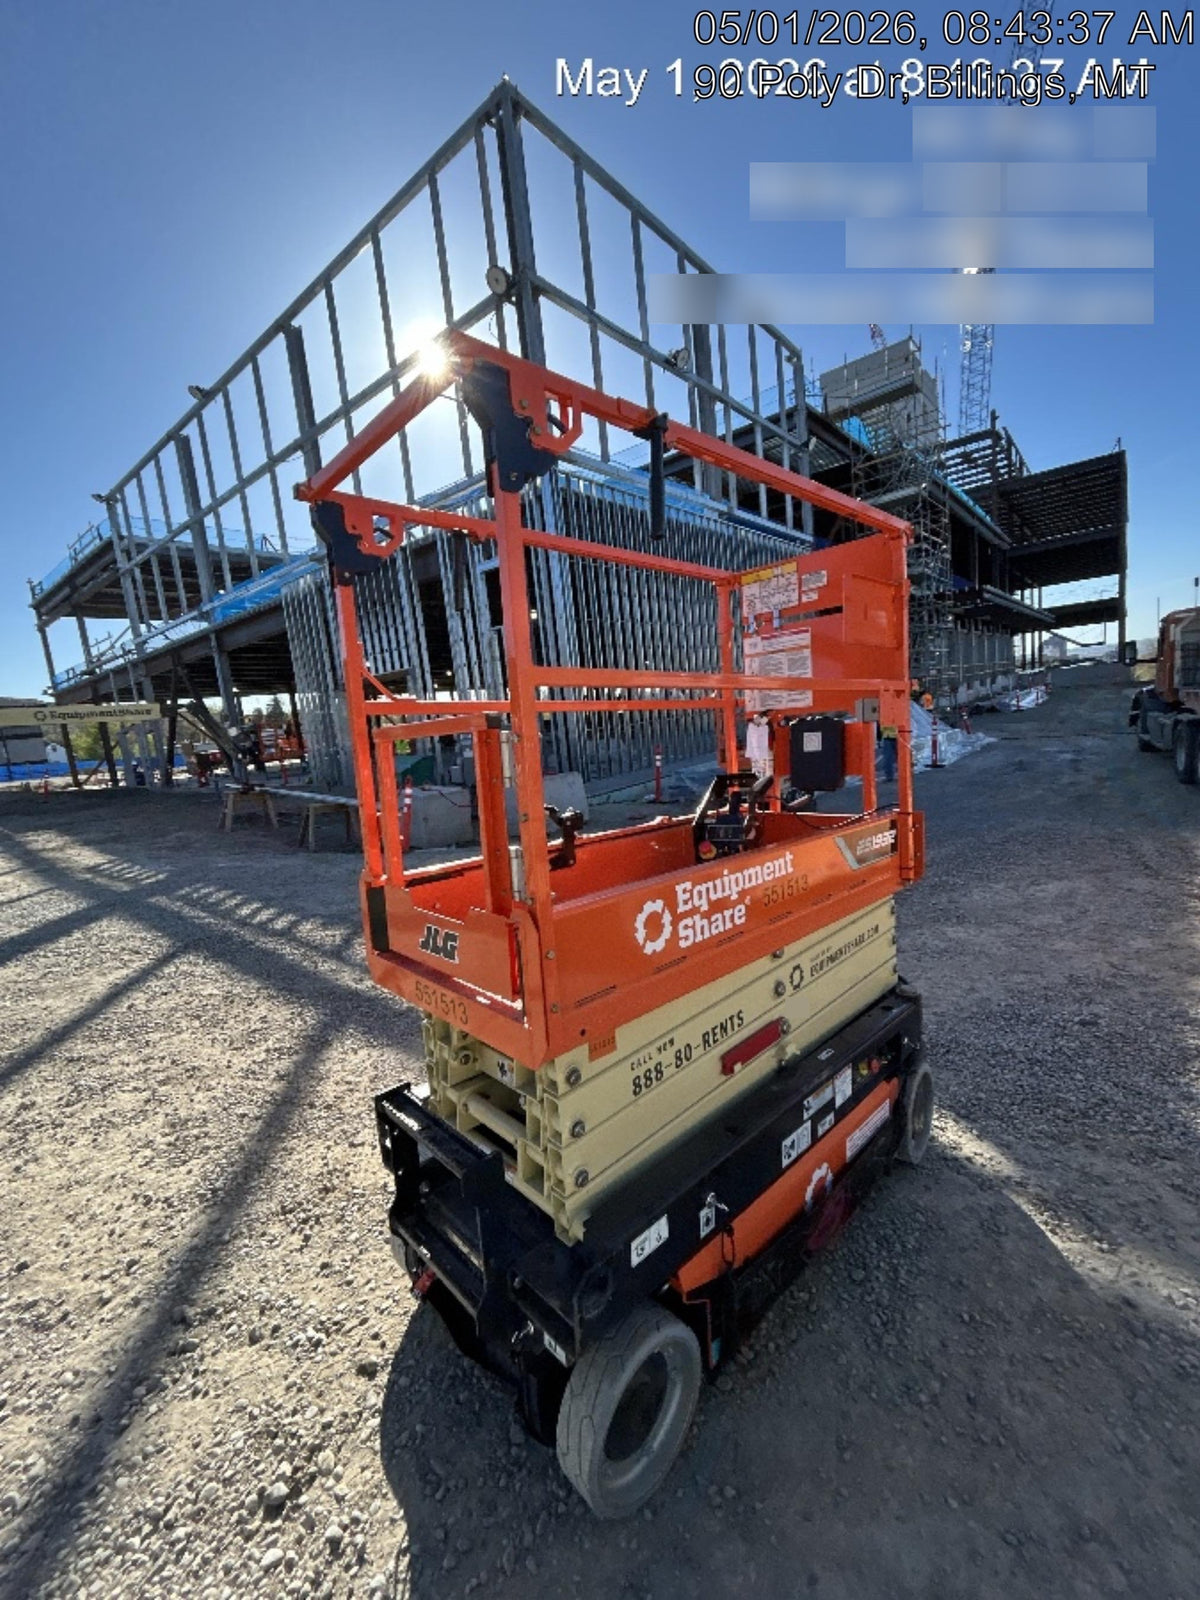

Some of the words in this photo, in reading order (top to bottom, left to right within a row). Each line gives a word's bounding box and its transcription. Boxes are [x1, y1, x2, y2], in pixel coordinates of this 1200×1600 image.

[675, 851, 794, 914] Equipment
[762, 873, 808, 908] 551513
[419, 924, 460, 964] JLG
[678, 903, 746, 948] Share
[415, 980, 468, 1025] 551513
[630, 1052, 653, 1072] CALL
[631, 1008, 745, 1098] 888-80-RENTS
